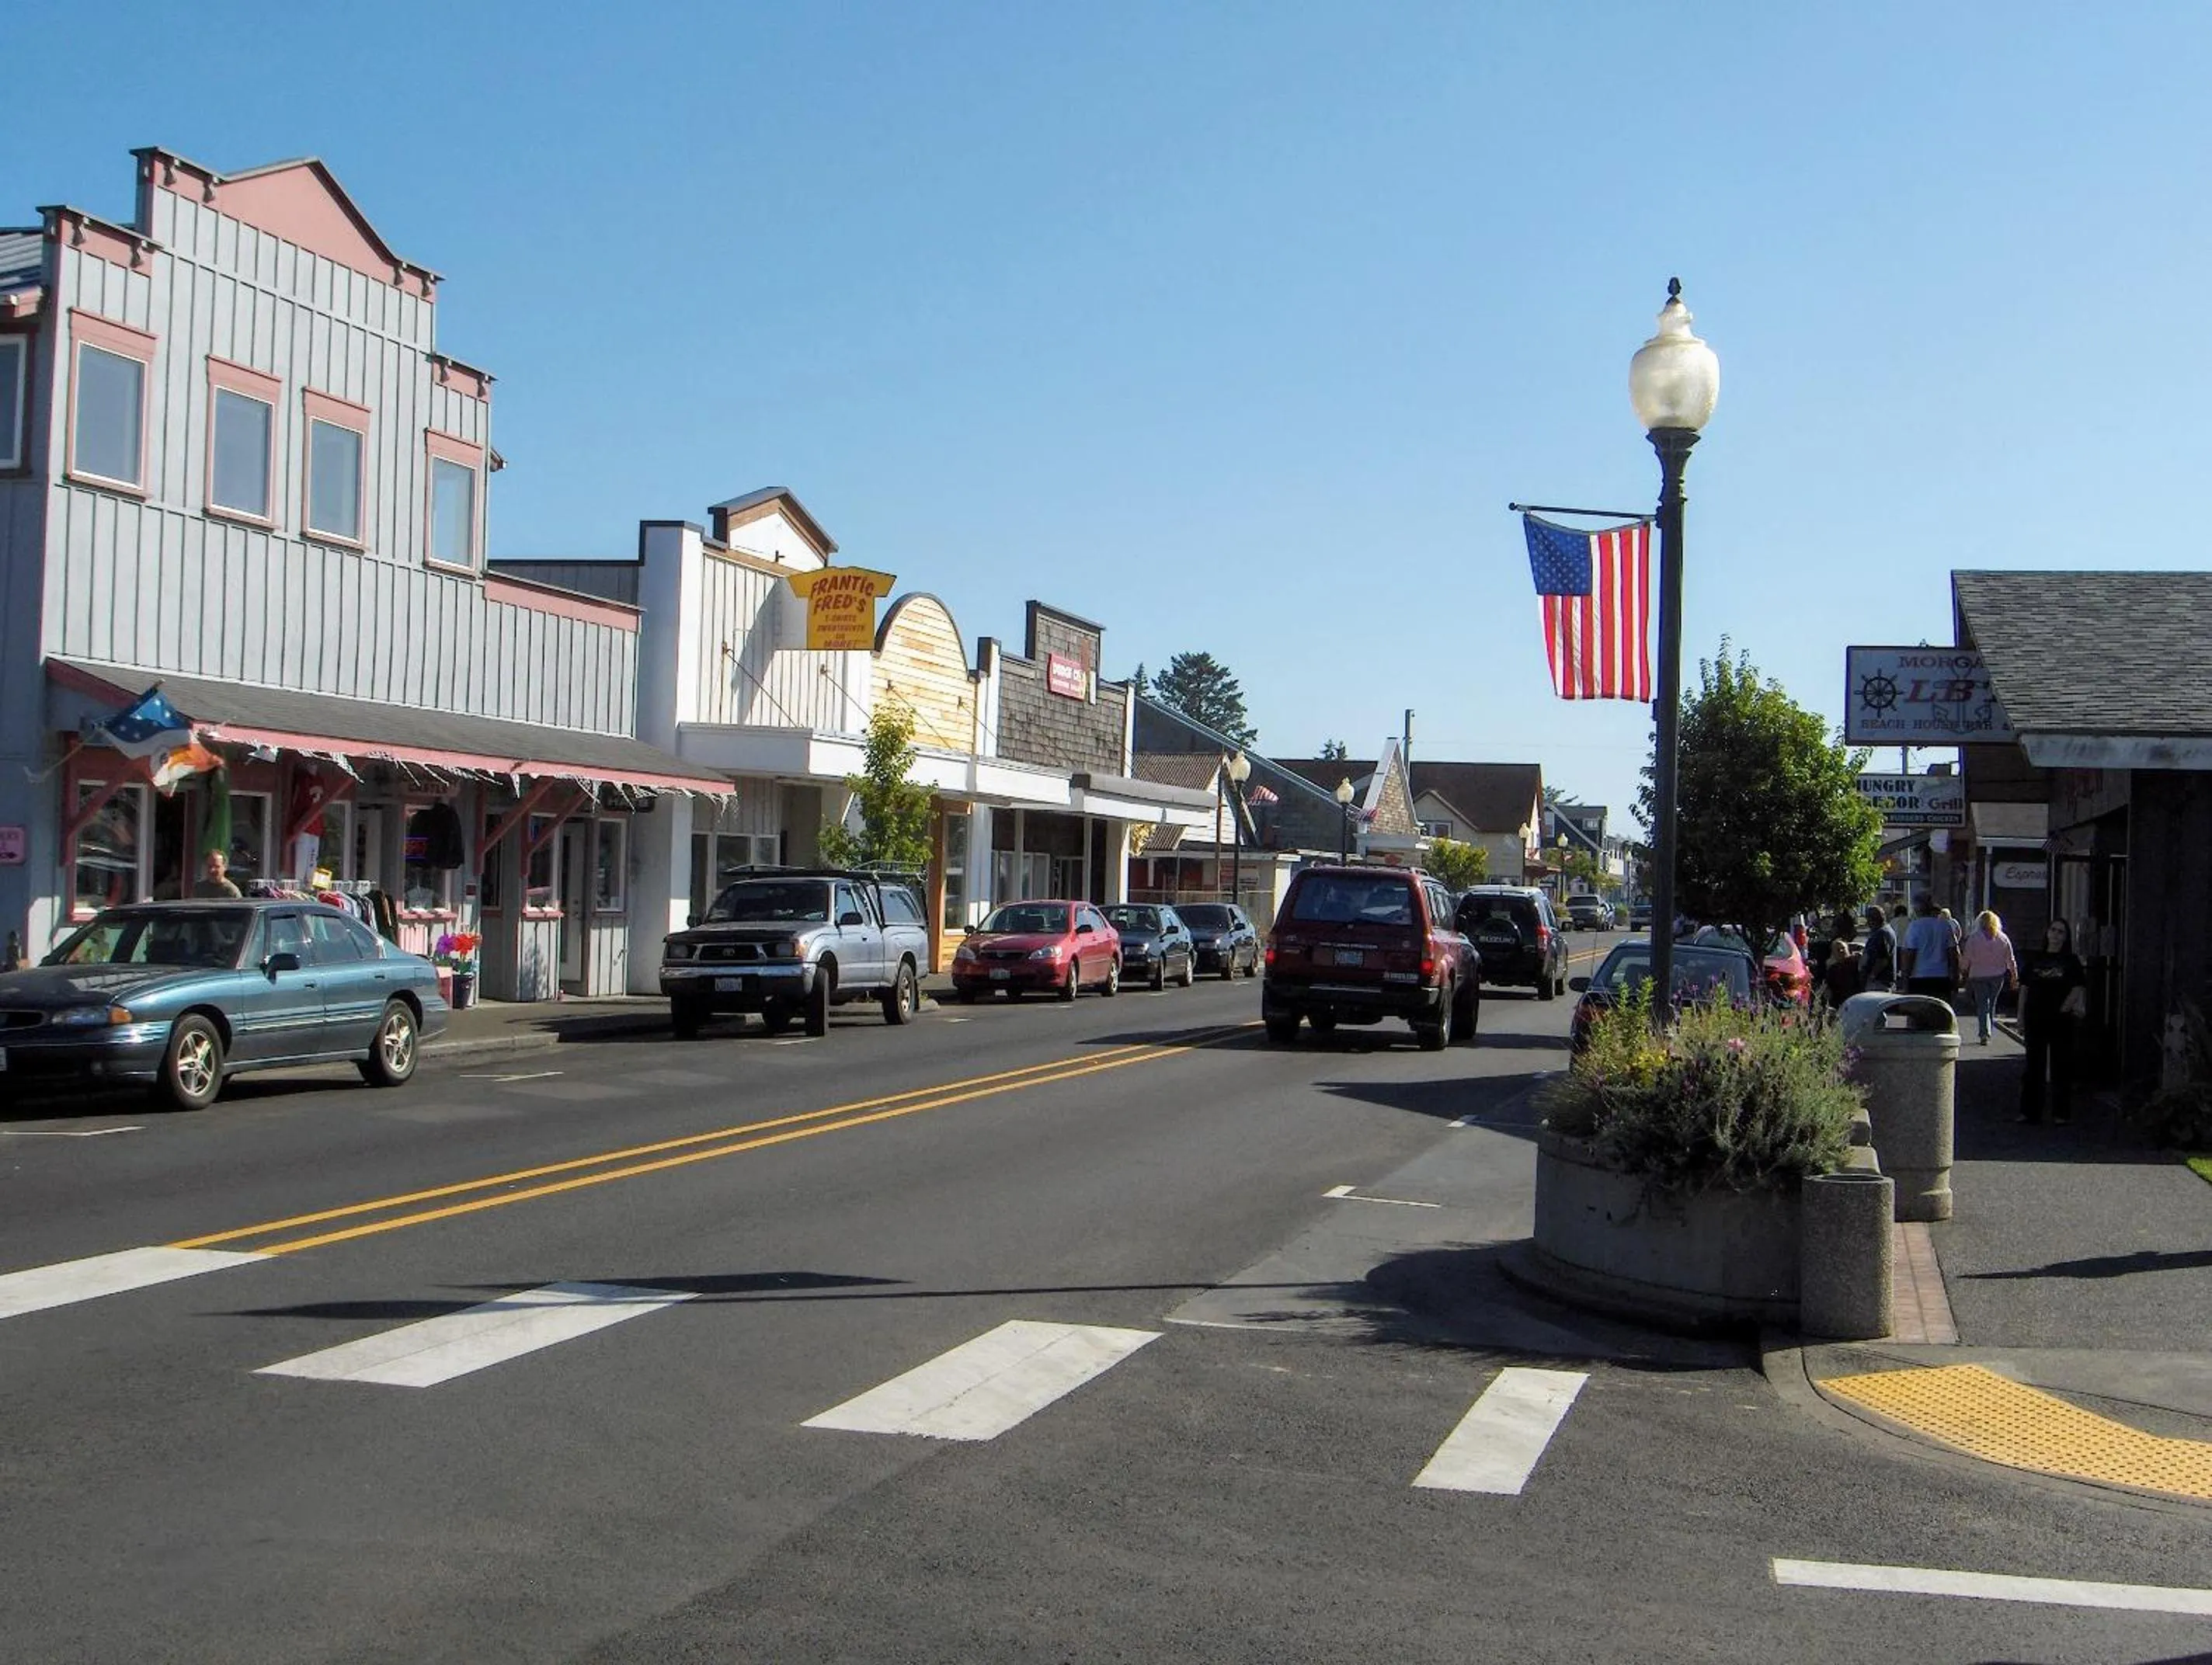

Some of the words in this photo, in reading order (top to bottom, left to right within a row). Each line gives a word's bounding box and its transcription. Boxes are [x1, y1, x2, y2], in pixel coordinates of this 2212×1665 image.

[811, 575, 875, 599] FRANTIC
[813, 594, 867, 615] FRED'S
[1861, 719, 1904, 731] BEACH
[1478, 935, 1516, 944] SUZUKI
